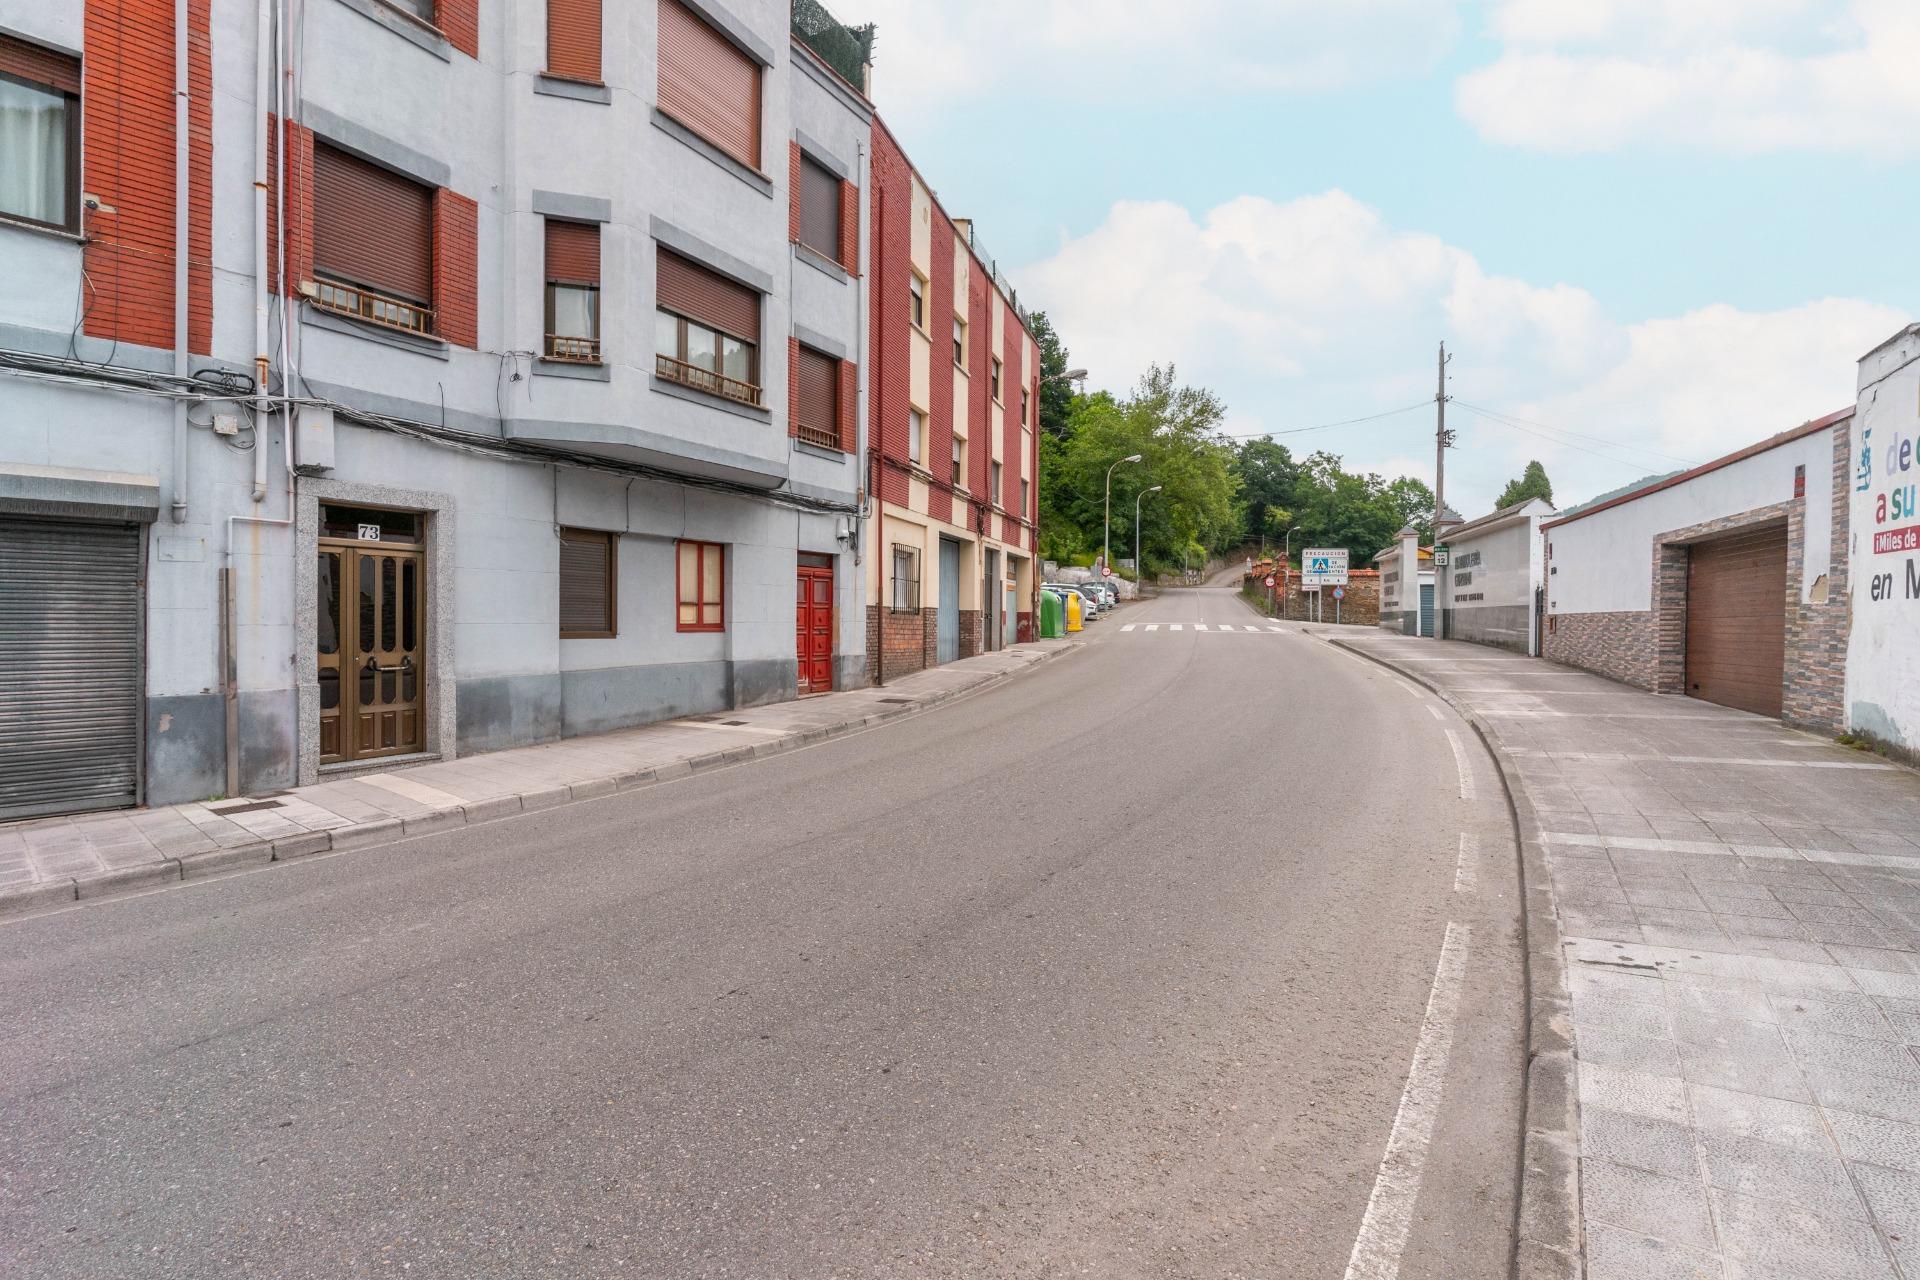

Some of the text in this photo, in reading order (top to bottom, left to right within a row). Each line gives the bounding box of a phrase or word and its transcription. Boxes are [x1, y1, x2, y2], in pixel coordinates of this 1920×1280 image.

[359, 525, 379, 540] 73
[1904, 529, 1917, 548] de
[1871, 573, 1893, 601] en
